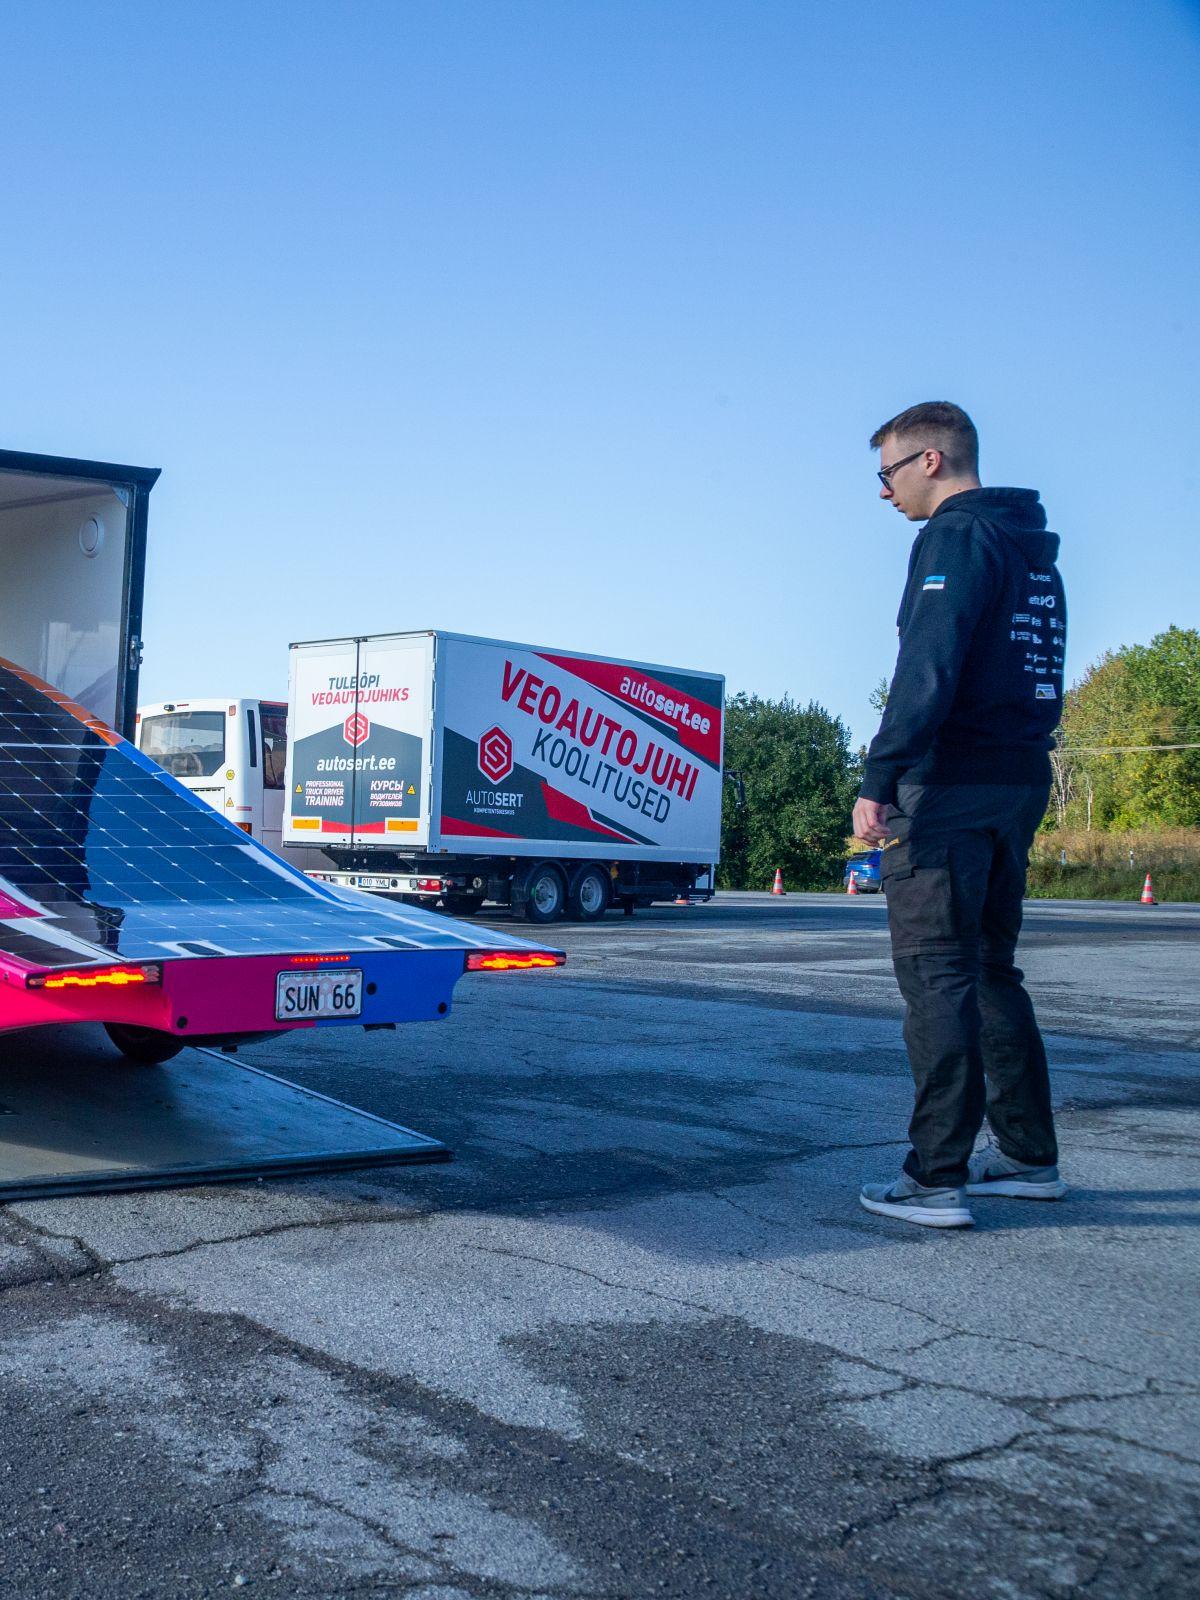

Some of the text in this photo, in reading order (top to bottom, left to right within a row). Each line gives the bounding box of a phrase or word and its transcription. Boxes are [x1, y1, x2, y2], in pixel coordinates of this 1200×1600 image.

[328, 672, 381, 690] TULE ÕPI
[311, 687, 410, 706] VEOAUTOJUHIKS
[619, 675, 711, 735] autosert.ee
[501, 660, 700, 802] VEOAUTOJUHI
[316, 755, 396, 771] autosert.ee
[530, 727, 671, 824] KOOLITUSED
[305, 788, 344, 796] TRUCK DRIVER
[370, 780, 404, 791] КУРСЫ
[305, 796, 344, 806] TRAINING
[370, 792, 403, 800] ВОДИТЕЛЕЙ
[465, 790, 524, 807] AUTOSERT
[362, 877, 373, 886] 010
[284, 984, 356, 1012] SUN 66
